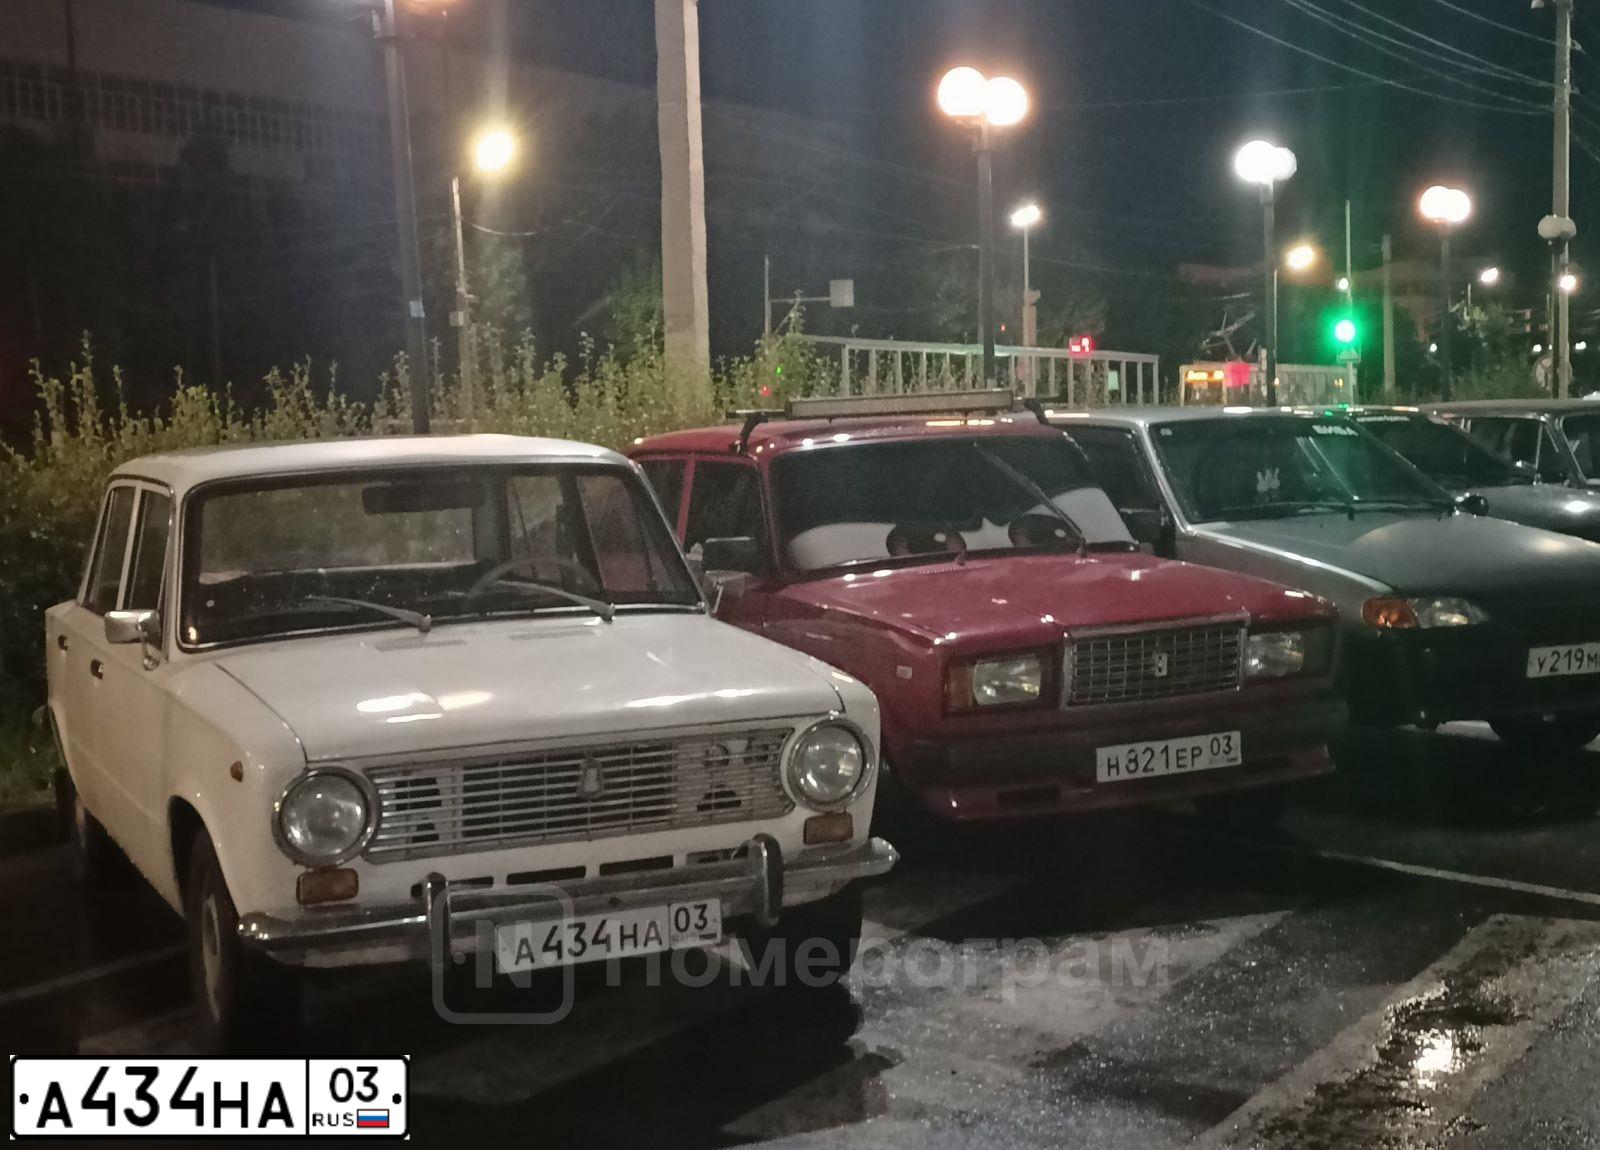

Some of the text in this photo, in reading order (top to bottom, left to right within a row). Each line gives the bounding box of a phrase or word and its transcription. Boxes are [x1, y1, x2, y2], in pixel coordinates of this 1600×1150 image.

[1537, 648, 1600, 672] У219М
[1107, 735, 1232, 776] Н821ЕР 03
[515, 903, 708, 965] А434НА 03
